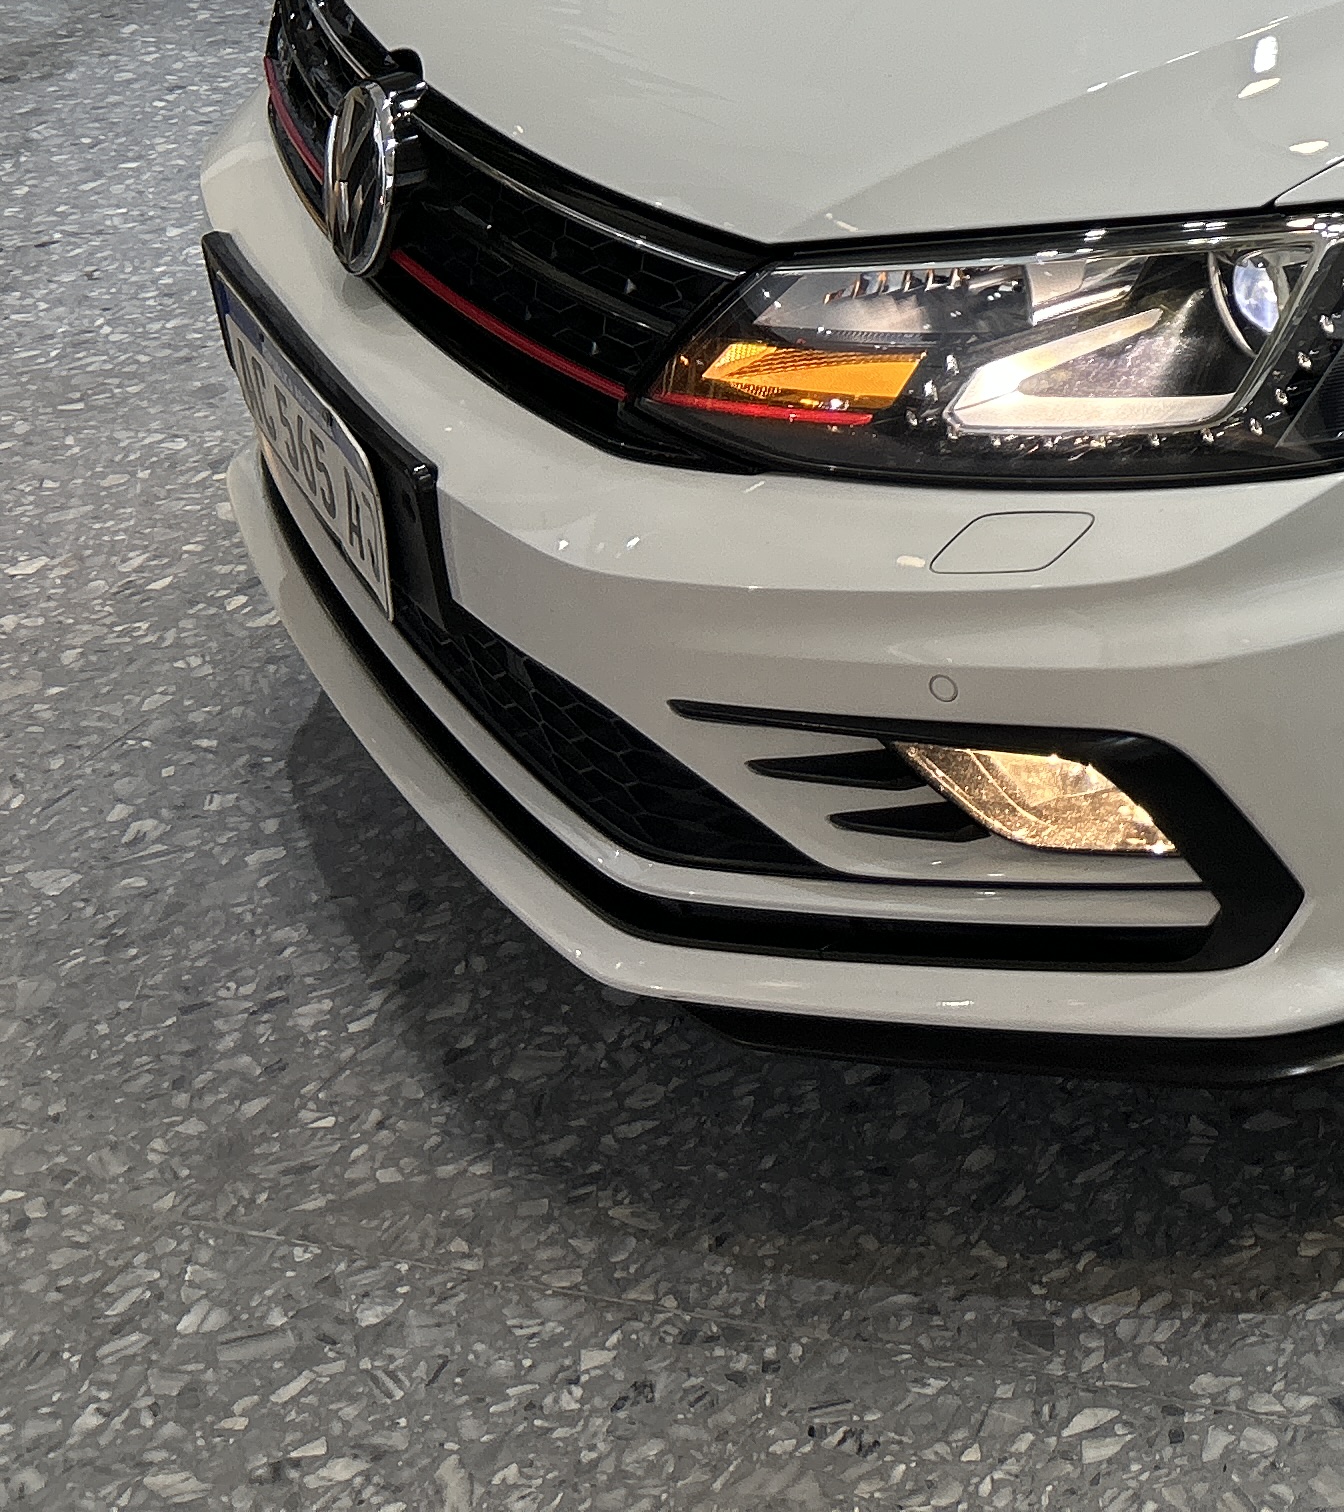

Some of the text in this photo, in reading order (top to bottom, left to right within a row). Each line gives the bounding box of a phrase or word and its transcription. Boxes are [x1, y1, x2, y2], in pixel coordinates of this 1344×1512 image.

[236, 337, 277, 441] AC
[274, 384, 337, 520] 565
[343, 465, 381, 583] AJ
